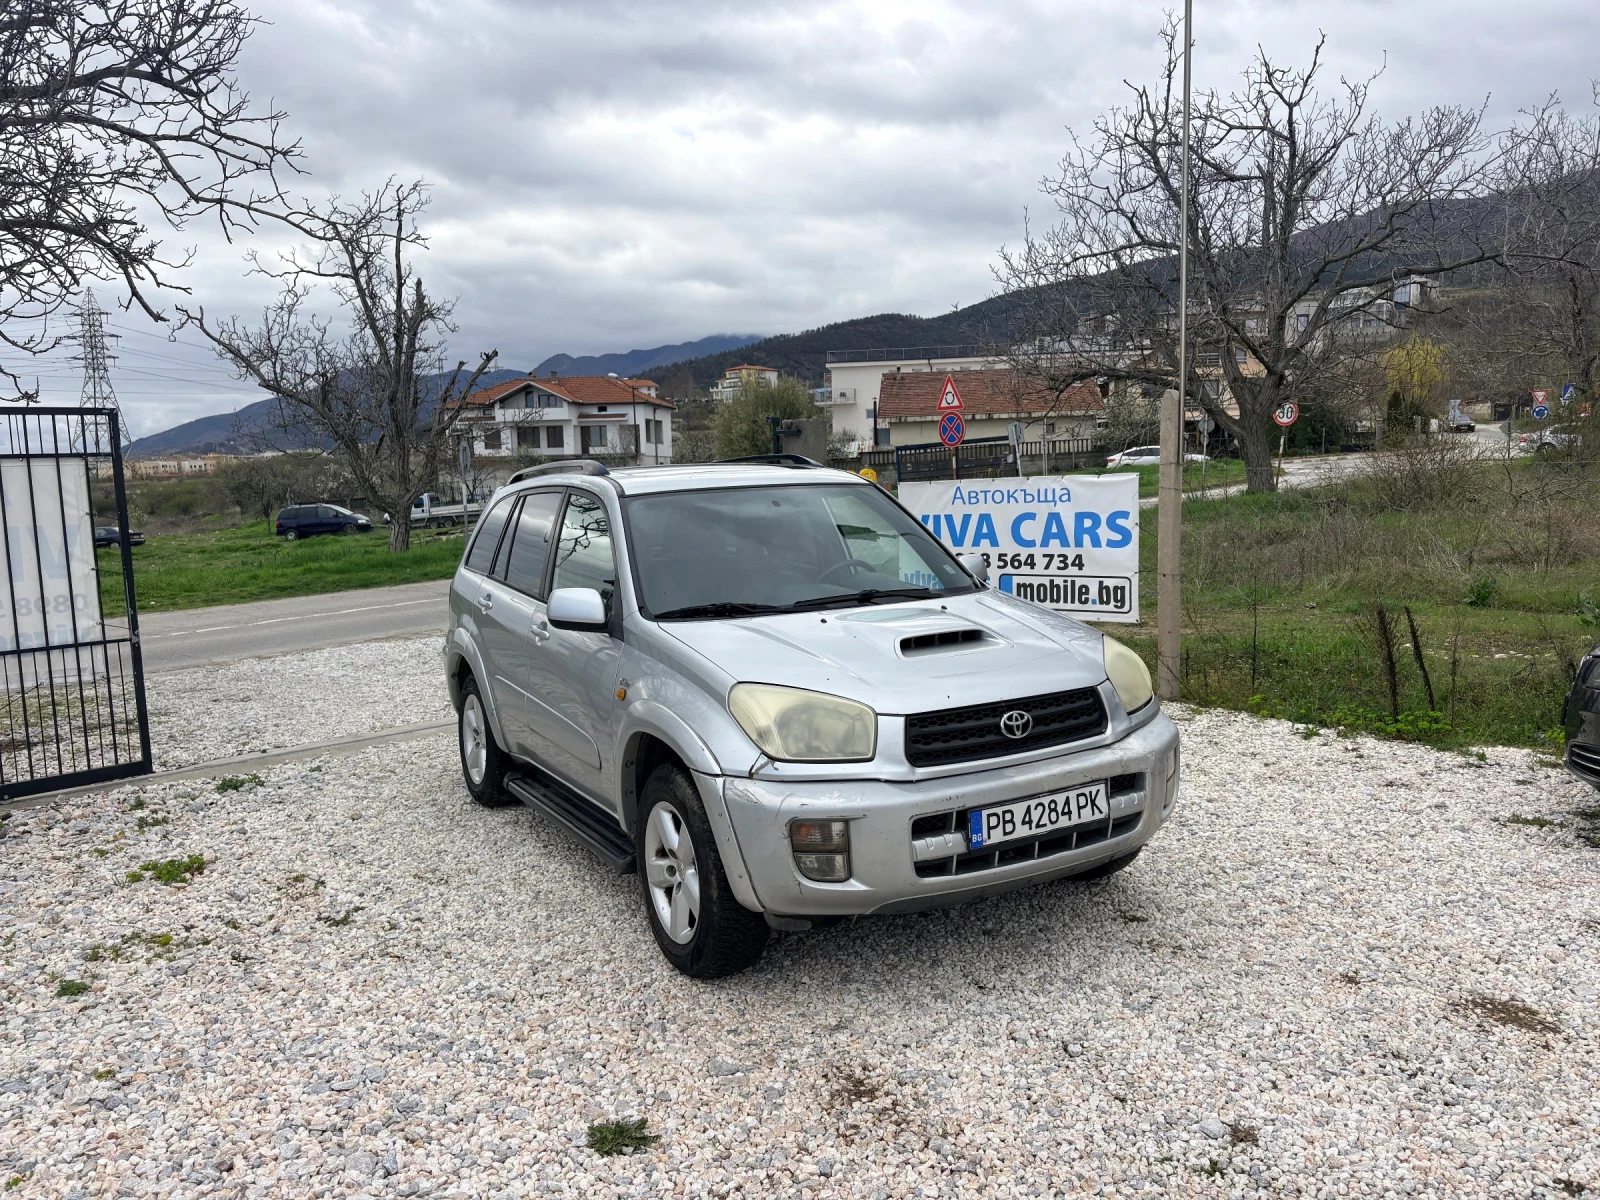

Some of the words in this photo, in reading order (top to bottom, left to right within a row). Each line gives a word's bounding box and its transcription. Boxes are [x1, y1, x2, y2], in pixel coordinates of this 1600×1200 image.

[951, 485, 1072, 507] Автокъща
[1010, 510, 1133, 549] CARS
[997, 553, 1036, 570] 564
[1042, 553, 1085, 570] 734
[1016, 579, 1126, 609] mobile.bg
[986, 808, 1016, 840] PB
[1021, 795, 1073, 831] 4284
[1075, 788, 1104, 820] PK
[972, 833, 982, 843] BG
